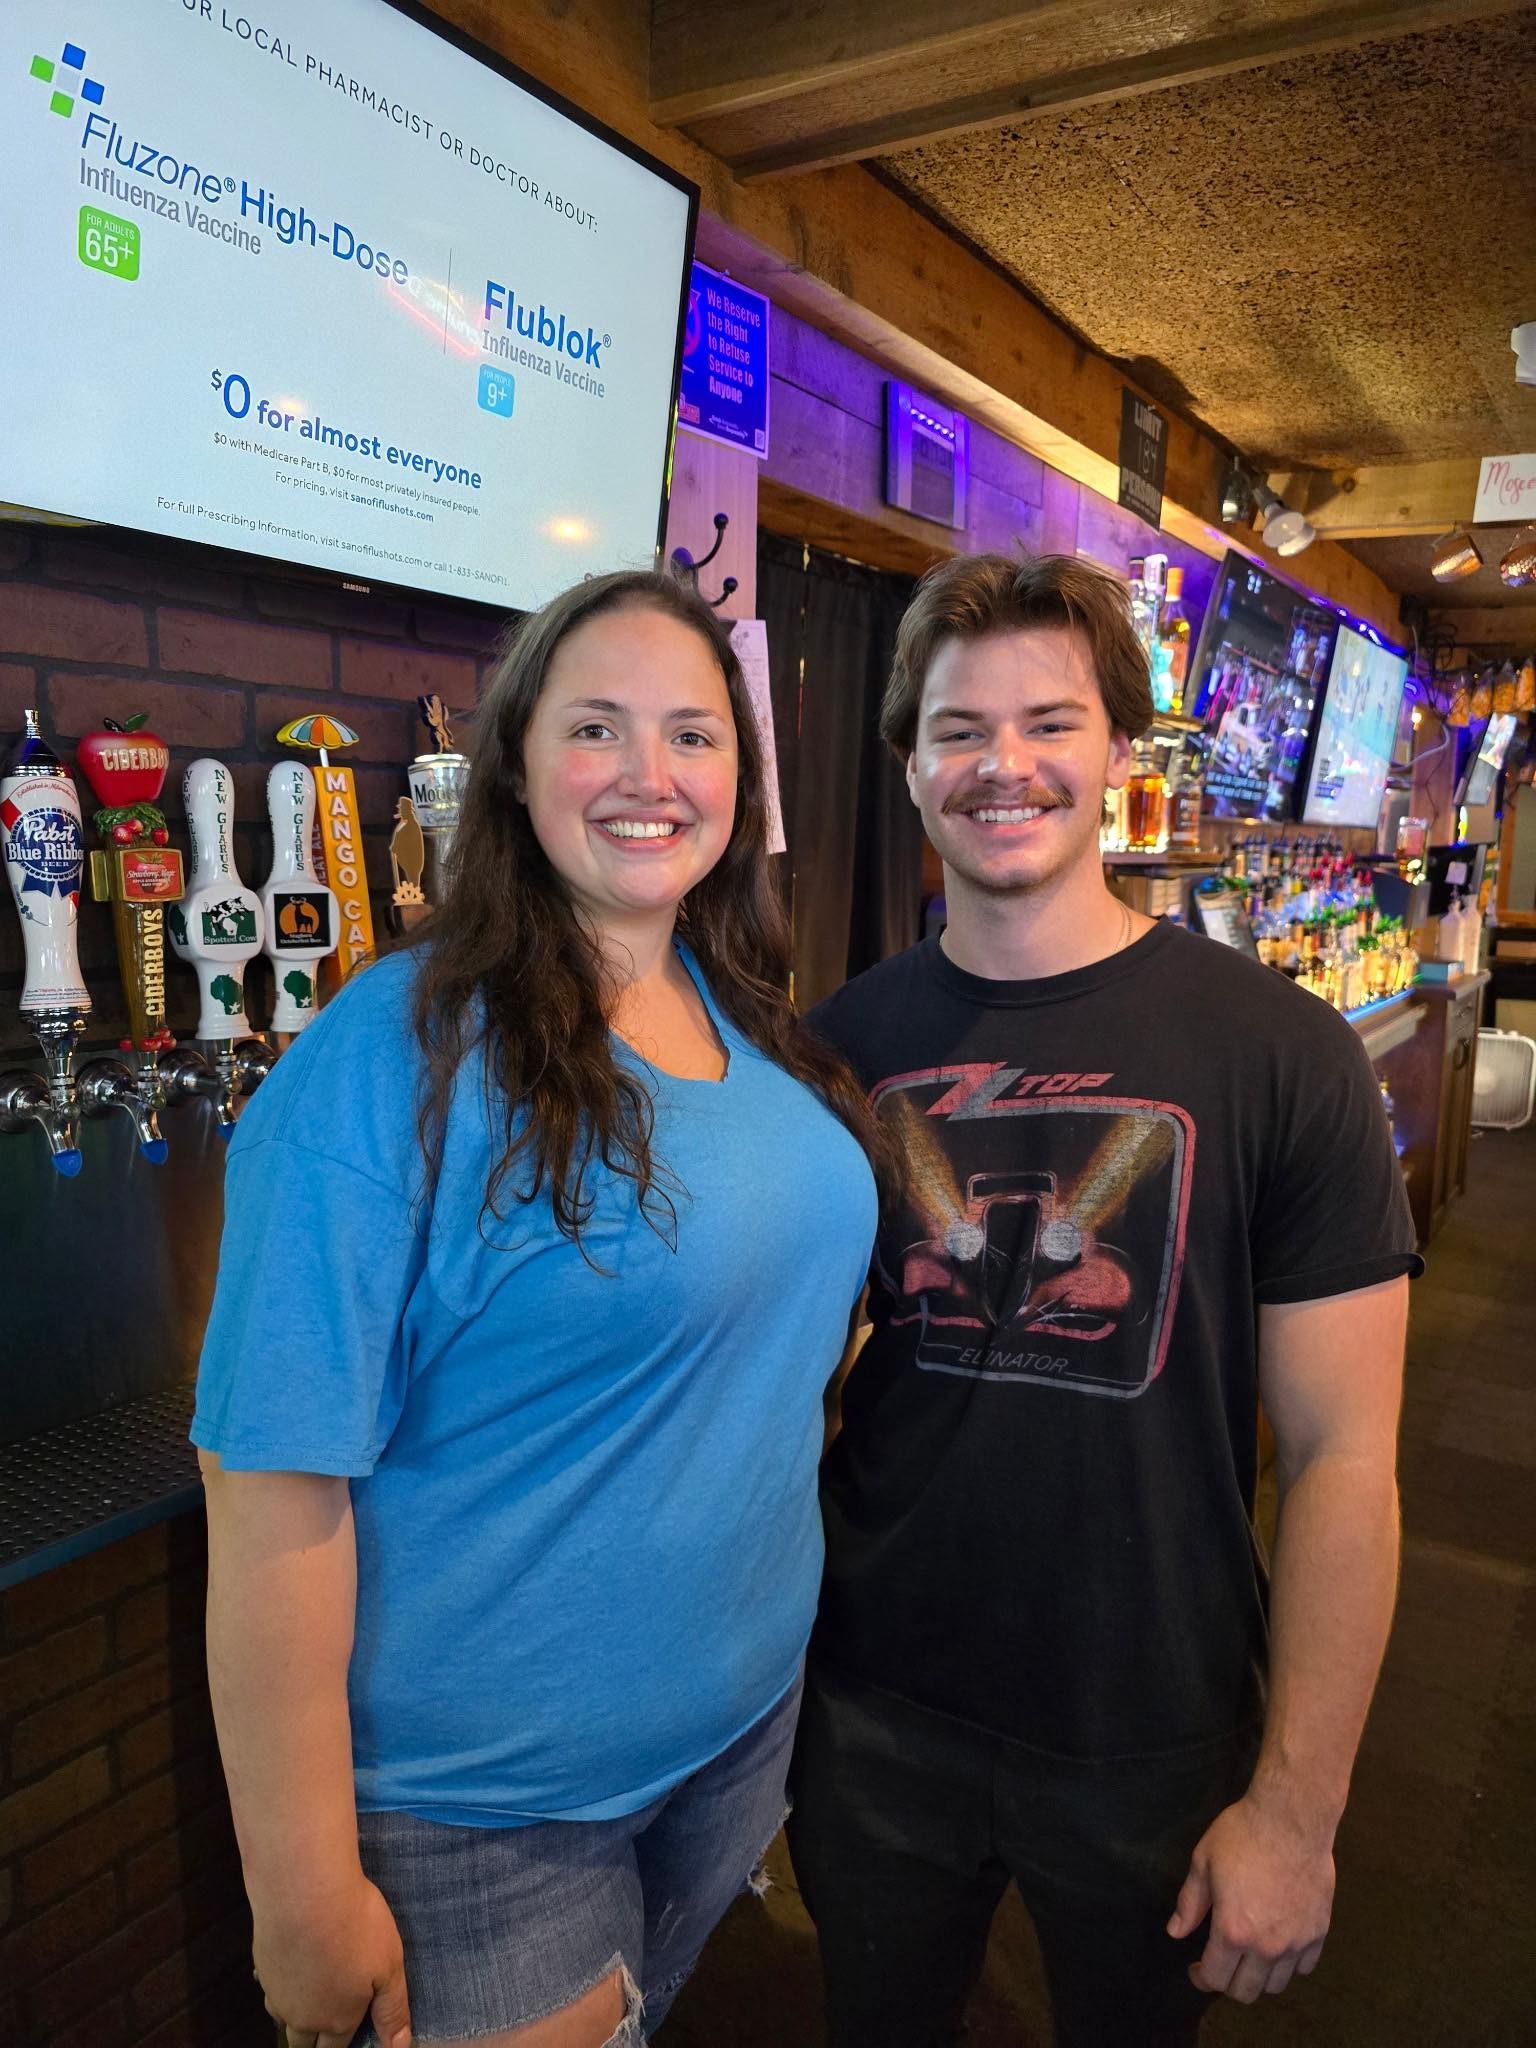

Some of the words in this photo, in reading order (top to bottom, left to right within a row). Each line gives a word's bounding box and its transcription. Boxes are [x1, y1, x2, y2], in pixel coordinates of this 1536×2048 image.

[222, 8, 297, 67] LOCAL
[306, 55, 434, 139] PHARMACIST
[440, 131, 463, 159] OR
[470, 147, 539, 200] DOCTOR
[544, 191, 598, 233] ABOUT:
[79, 157, 181, 223] Influenza
[184, 201, 262, 255] Vaccine
[86, 214, 102, 227] FOR
[105, 221, 134, 240] ADULTS
[240, 180, 409, 285] High-Dose
[86, 228, 134, 268] 65+
[706, 288, 722, 310] We
[723, 296, 760, 328] Reserve
[707, 311, 723, 331] the
[724, 316, 749, 345] Right
[482, 329, 551, 377] Influenza
[554, 360, 606, 399] Vaccine
[708, 333, 717, 350] to
[719, 337, 750, 365] Refuse
[709, 355, 743, 382] Service
[745, 368, 754, 387] to
[709, 375, 743, 404] Anyone
[488, 382, 507, 407] 9+
[210, 368, 250, 418] $0
[256, 400, 295, 432] for
[300, 416, 382, 460] almost
[386, 446, 482, 489] everyone
[213, 432, 227, 445] $0
[229, 438, 252, 453] with
[254, 443, 299, 465] Medicare
[301, 456, 320, 472] Part
[322, 463, 331, 475] B,
[333, 465, 345, 478] $0
[346, 469, 359, 482] for
[360, 475, 384, 489] most
[385, 483, 421, 501] privately
[422, 492, 452, 508] insured
[453, 501, 481, 517] people.
[275, 471, 291, 485] For
[293, 477, 328, 496] pricing,
[329, 487, 349, 500] visit
[350, 493, 434, 522] sanofiflushots.com
[157, 496, 175, 510] For
[178, 501, 195, 515] full
[197, 505, 256, 531] Prescribing
[258, 519, 318, 545] Information,
[320, 536, 340, 549] visit
[341, 541, 423, 567] sanofiflushots.com
[423, 561, 432, 569] or
[433, 562, 447, 573] call
[342, 582, 370, 594] SAMSUNG
[214, 769, 227, 804] NEW
[292, 771, 304, 805] NEW
[23, 816, 75, 843] Pabst
[217, 812, 230, 873] GLARUS
[293, 813, 304, 871] GLARUS
[325, 771, 358, 888] MANGO
[8, 842, 41, 861] Blue
[204, 935, 237, 945] Spotted
[239, 934, 256, 942] Cow
[144, 908, 165, 1016] CIDERBOYS
[1016, 1073, 1115, 1096] TOP
